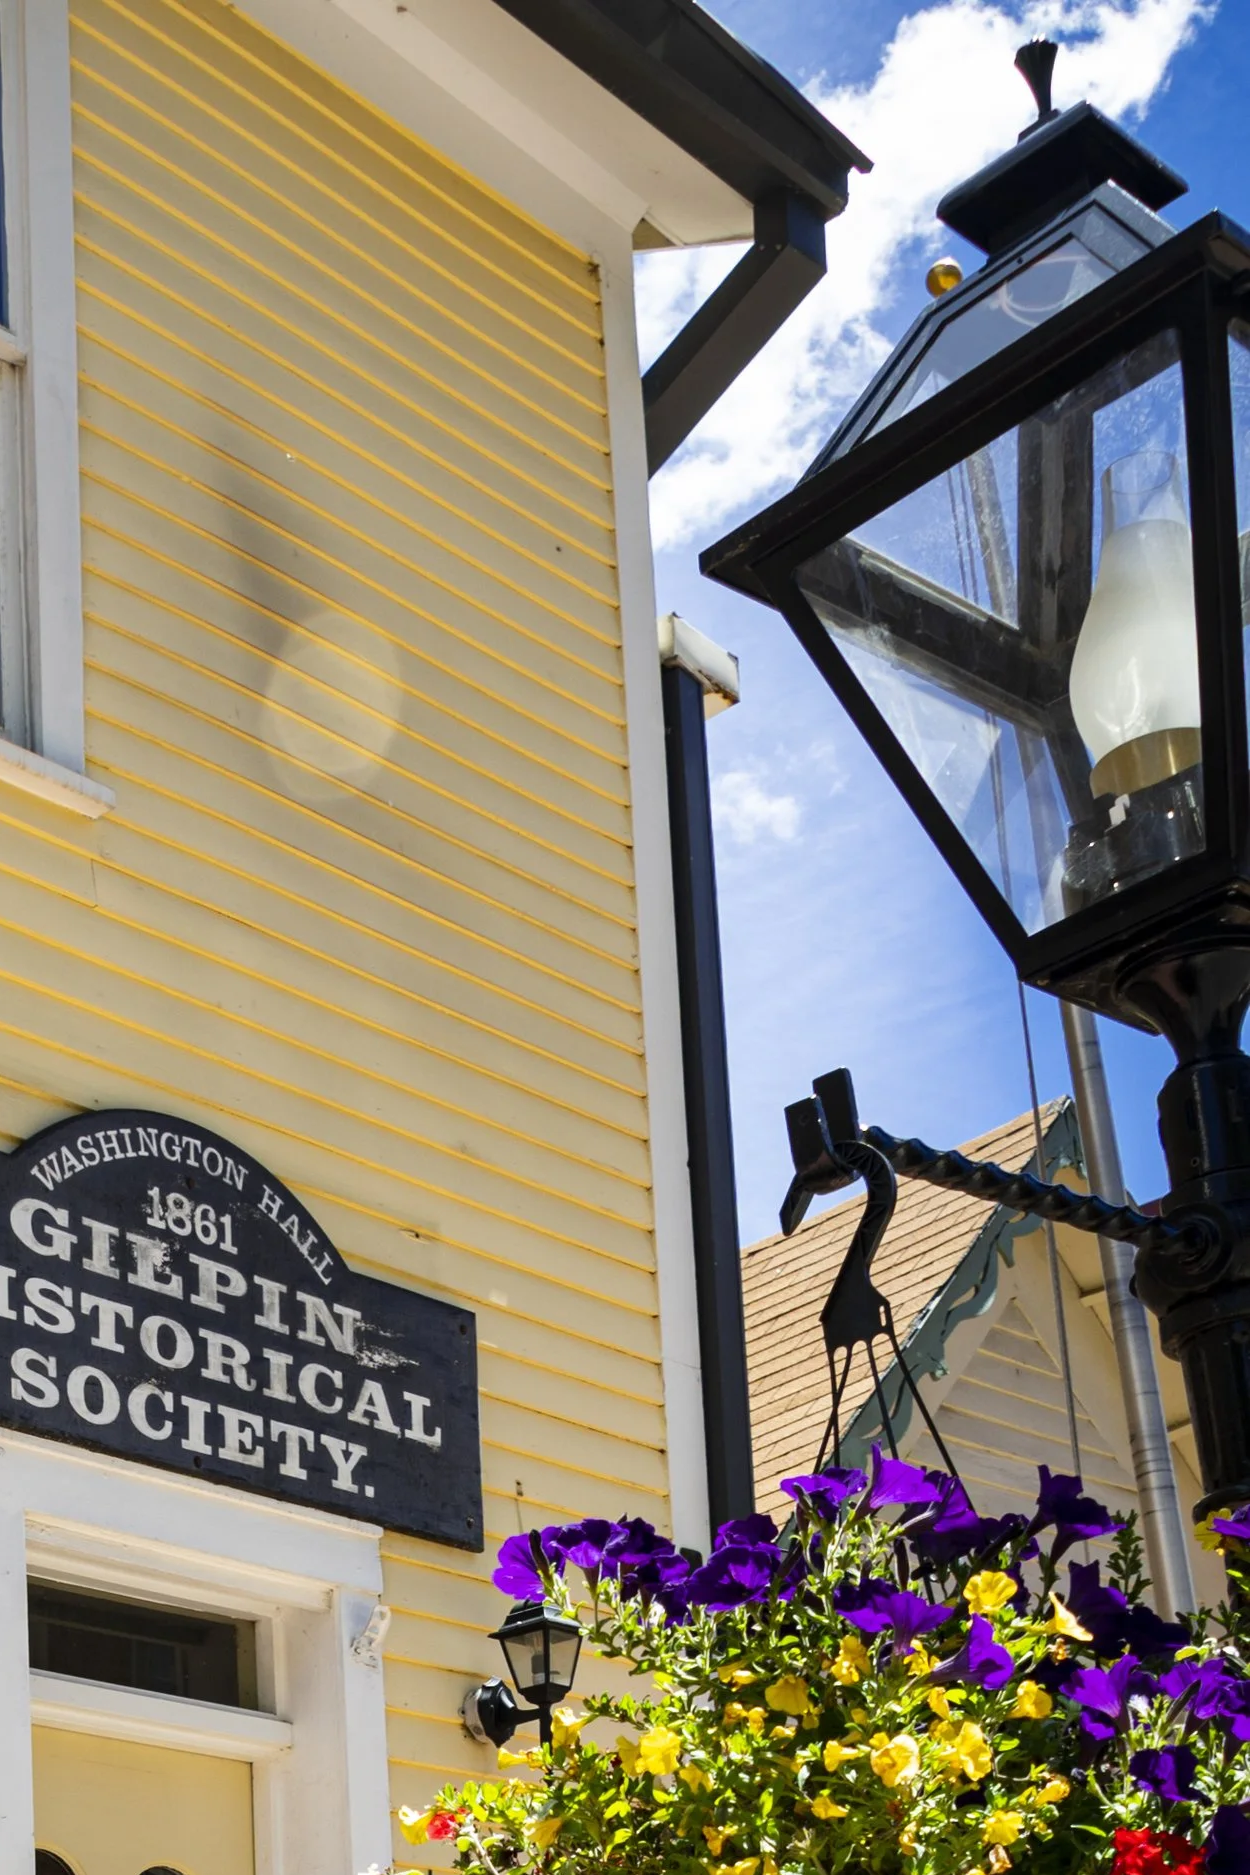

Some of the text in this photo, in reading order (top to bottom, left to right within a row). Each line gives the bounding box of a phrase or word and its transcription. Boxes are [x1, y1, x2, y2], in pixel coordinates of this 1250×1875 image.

[10, 1197, 361, 1355] GILPIN
[30, 1126, 335, 1286] WASHINGTON HALL
[146, 1186, 238, 1255] 1861
[10, 1346, 375, 1498] SOCIETY.
